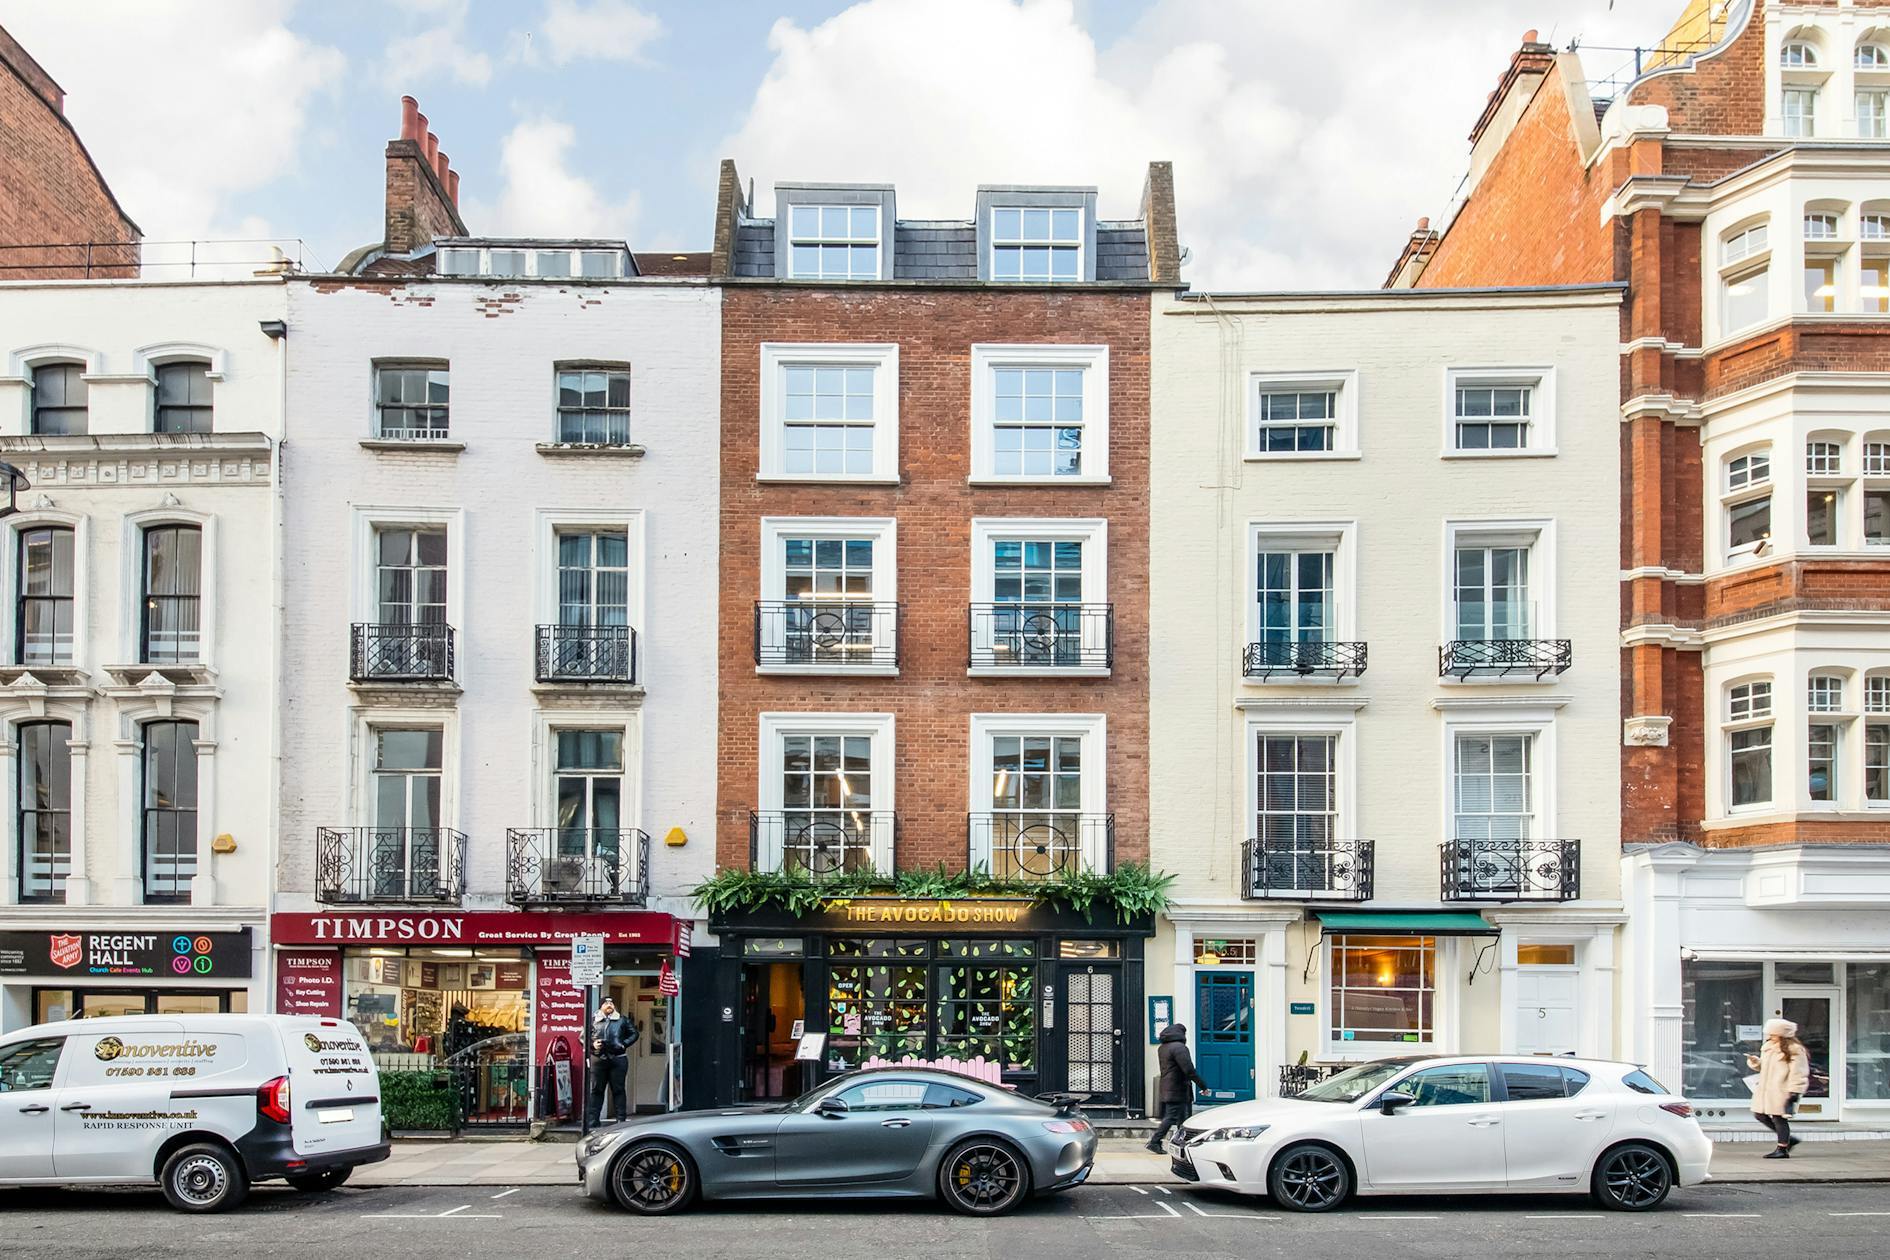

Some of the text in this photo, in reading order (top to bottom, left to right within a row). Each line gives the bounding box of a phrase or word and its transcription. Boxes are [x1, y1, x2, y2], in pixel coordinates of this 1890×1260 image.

[847, 906, 1018, 922] THE AVOCADO SHOW
[311, 918, 463, 939] TIMPSON
[540, 931, 552, 940] By
[58, 938, 69, 947] THE
[89, 935, 157, 950] REGENT
[52, 941, 81, 959] SALVATION
[62, 951, 79, 963] ARMY
[89, 951, 134, 965] HALL
[286, 958, 332, 966] TIMPSON
[542, 959, 572, 967] TIMPS
[1087, 965, 1094, 974] 6
[321, 976, 334, 984] I.D.
[295, 989, 326, 997] Key Cutting
[310, 1000, 329, 1008] Repairs
[1538, 1007, 1546, 1019] 5
[105, 1067, 144, 1077] 07590
[83, 1122, 114, 1130] RAPID
